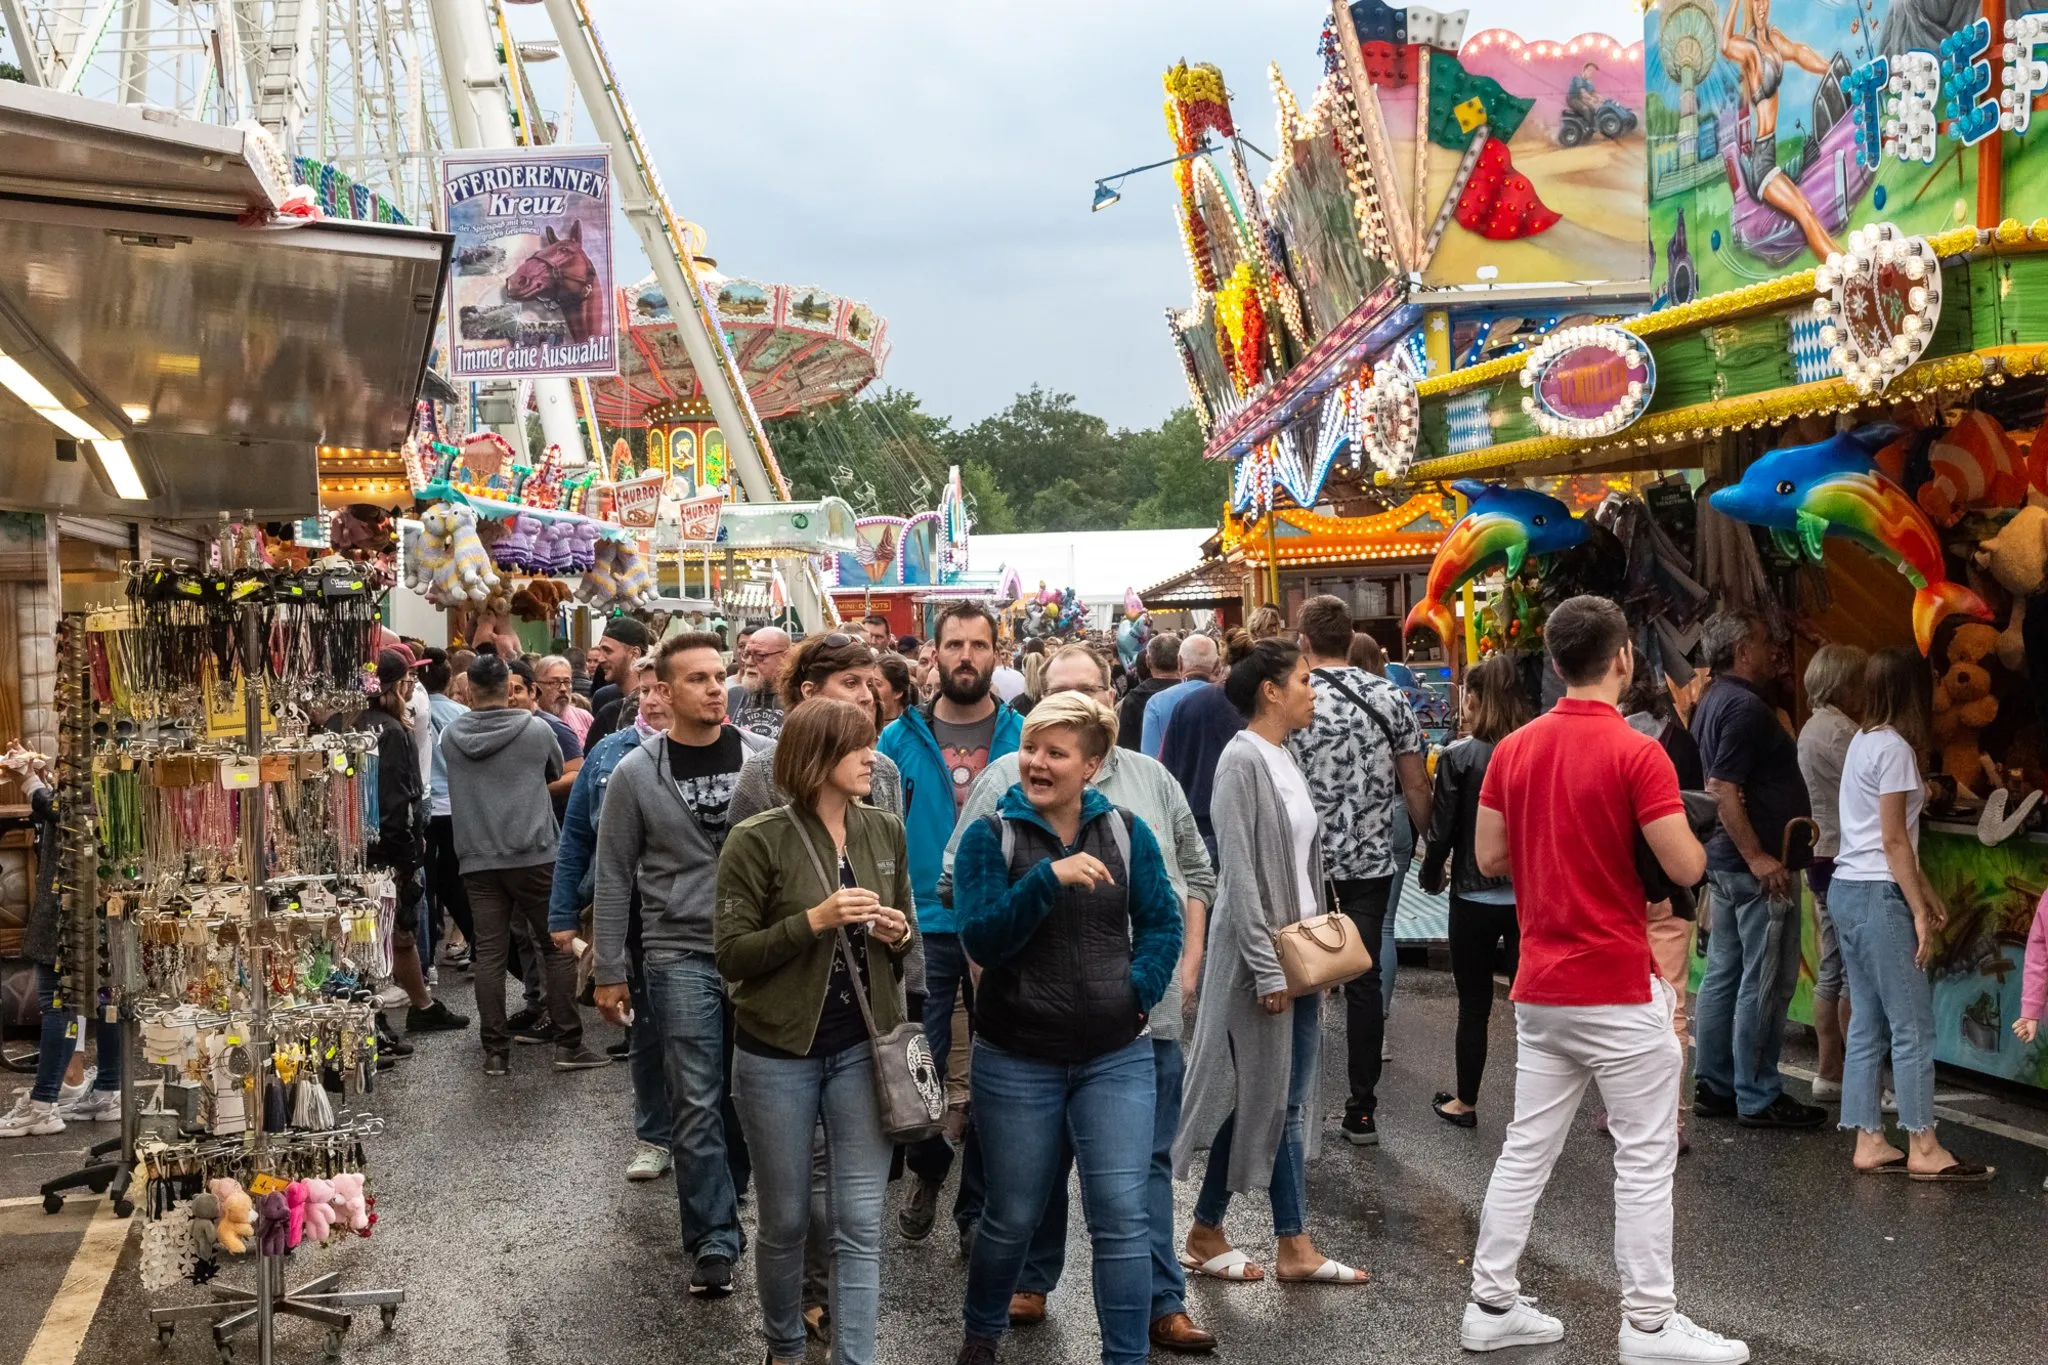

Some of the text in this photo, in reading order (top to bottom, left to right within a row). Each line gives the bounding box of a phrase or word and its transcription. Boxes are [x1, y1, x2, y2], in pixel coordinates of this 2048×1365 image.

[446, 166, 606, 203] PFERDERENNEN
[488, 193, 565, 216] Kreuz
[457, 336, 609, 372] Immer eine Auswahl!
[617, 485, 660, 508] CHURROS
[681, 503, 720, 523] CHURROS
